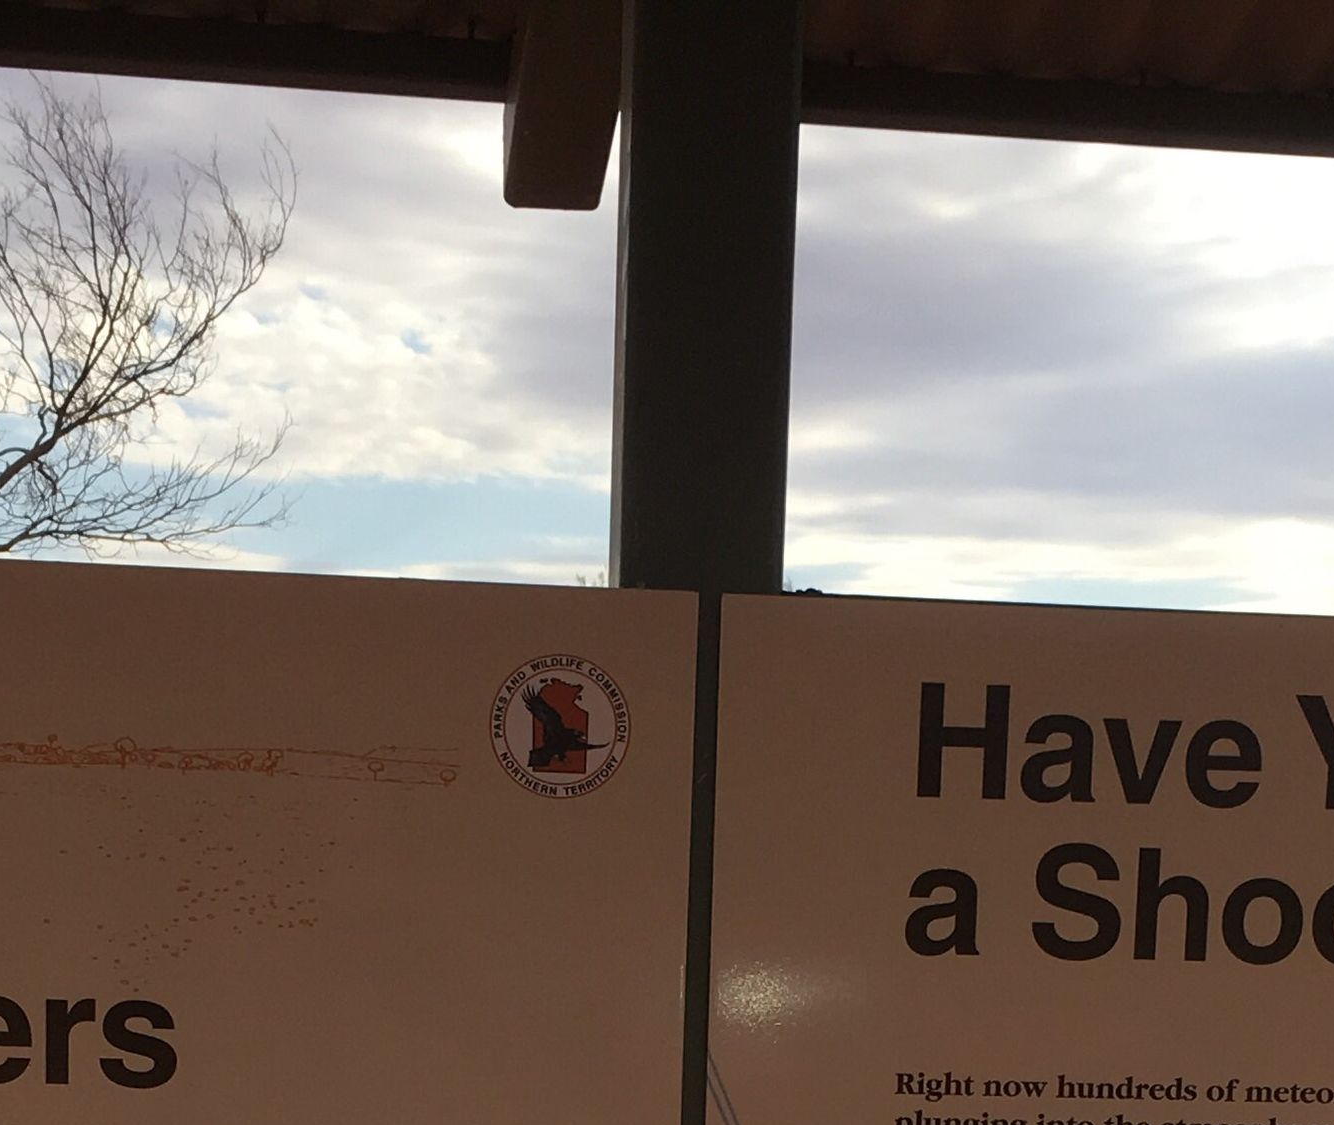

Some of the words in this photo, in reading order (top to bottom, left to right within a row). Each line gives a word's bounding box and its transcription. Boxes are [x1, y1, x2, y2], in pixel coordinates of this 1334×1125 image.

[494, 697, 508, 739] PARKS
[506, 671, 527, 693] AND
[530, 658, 585, 673] WILDLIFE
[588, 667, 628, 742] COMMISSION
[500, 752, 558, 796] NORTHERN
[563, 755, 619, 796] TERRITORY
[917, 682, 1262, 808] Have
[905, 869, 979, 956] a
[895, 1072, 974, 1102] Right
[983, 1080, 1047, 1097] now
[1056, 1075, 1197, 1101] hundreds
[1207, 1079, 1239, 1102] of
